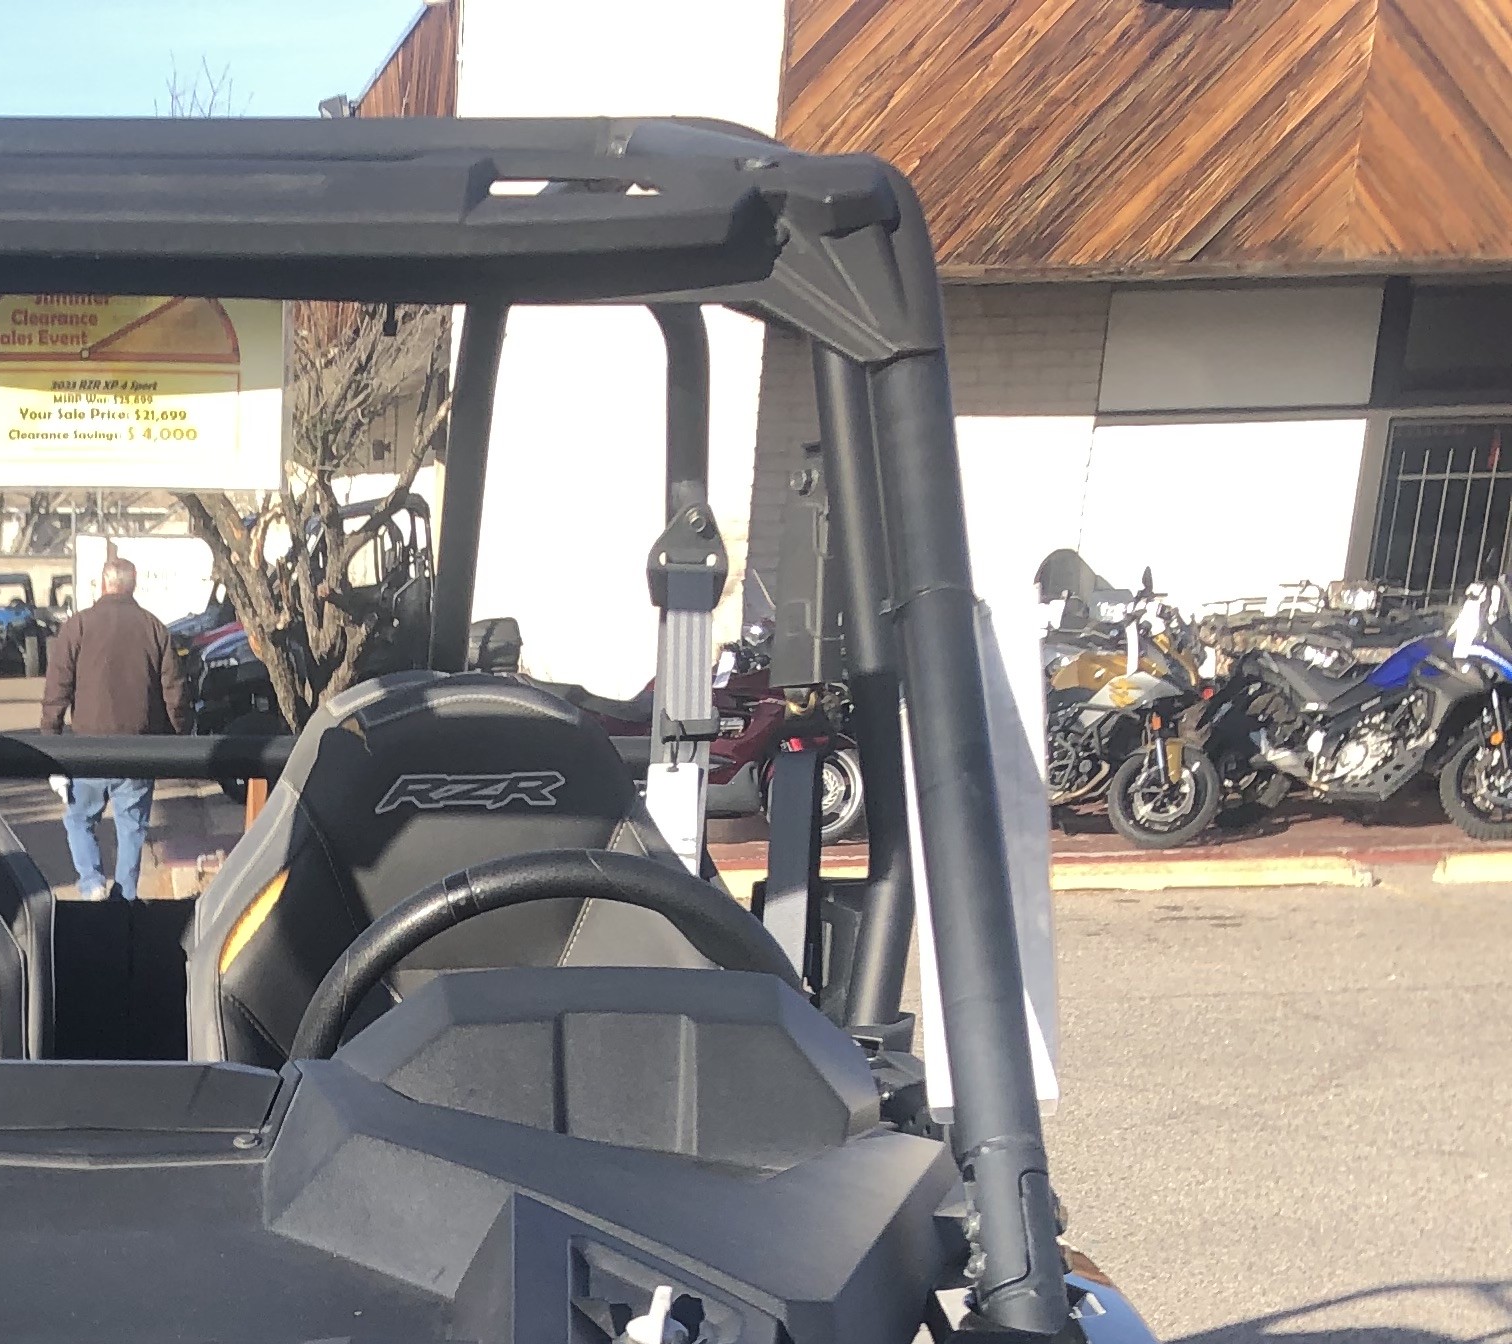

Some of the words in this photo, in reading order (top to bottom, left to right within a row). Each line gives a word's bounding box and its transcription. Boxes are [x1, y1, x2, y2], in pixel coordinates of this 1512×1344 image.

[11, 308, 99, 326] Clearance
[38, 329, 88, 346] Event
[79, 380, 102, 391] RZR
[103, 380, 119, 391] XP
[120, 381, 128, 391] 4
[130, 380, 158, 392] Sport
[19, 407, 52, 421] Your
[57, 407, 86, 421] Sale
[90, 408, 129, 421] Price:
[135, 409, 187, 422] $21,699
[8, 428, 70, 441] Clearance
[374, 770, 566, 815] RZR
